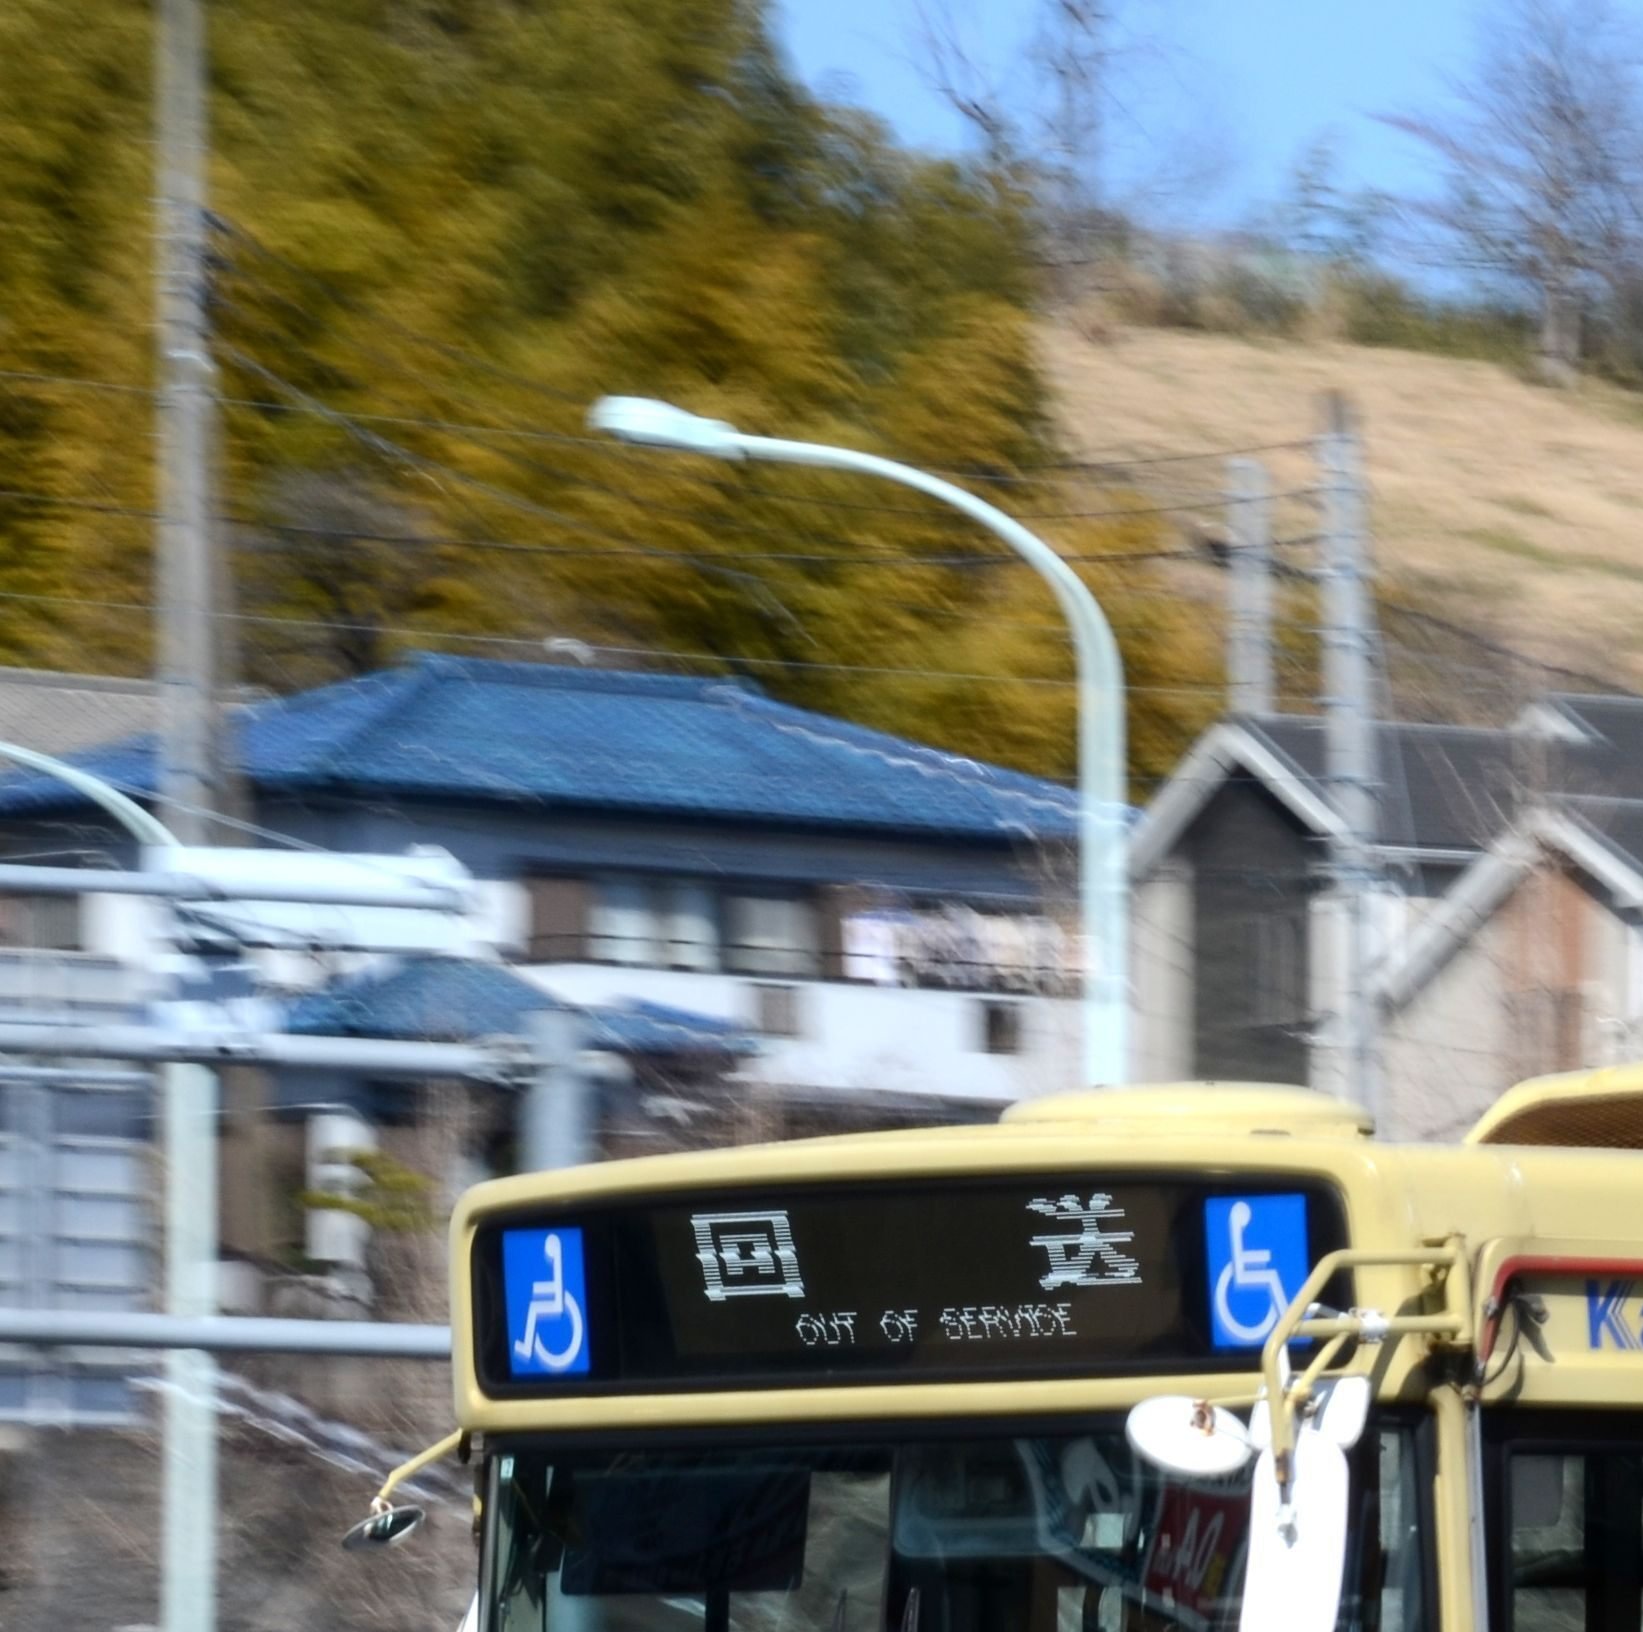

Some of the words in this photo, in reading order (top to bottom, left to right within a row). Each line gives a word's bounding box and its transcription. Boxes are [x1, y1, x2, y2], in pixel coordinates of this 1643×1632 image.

[796, 1312, 858, 1344] OUT
[880, 1310, 918, 1342] OF
[940, 1303, 1077, 1340] SERVICE
